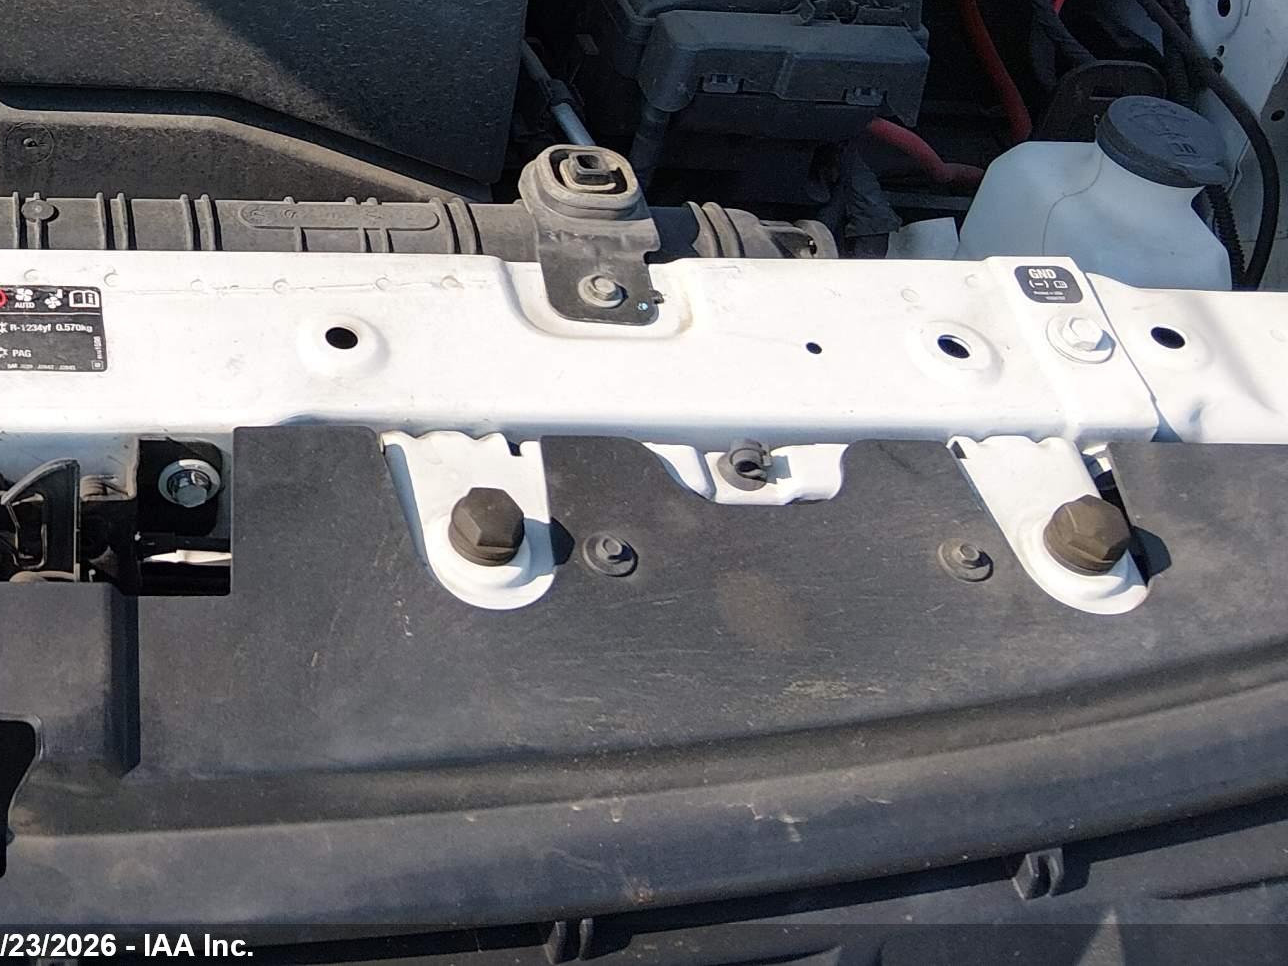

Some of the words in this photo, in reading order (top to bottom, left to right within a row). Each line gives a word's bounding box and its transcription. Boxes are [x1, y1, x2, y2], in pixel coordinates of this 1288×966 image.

[1028, 268, 1056, 279] GND
[14, 301, 36, 309] AUTO
[9, 323, 52, 333] R-1234yf
[55, 323, 93, 333] 0.570kg
[12, 349, 32, 358] PAG
